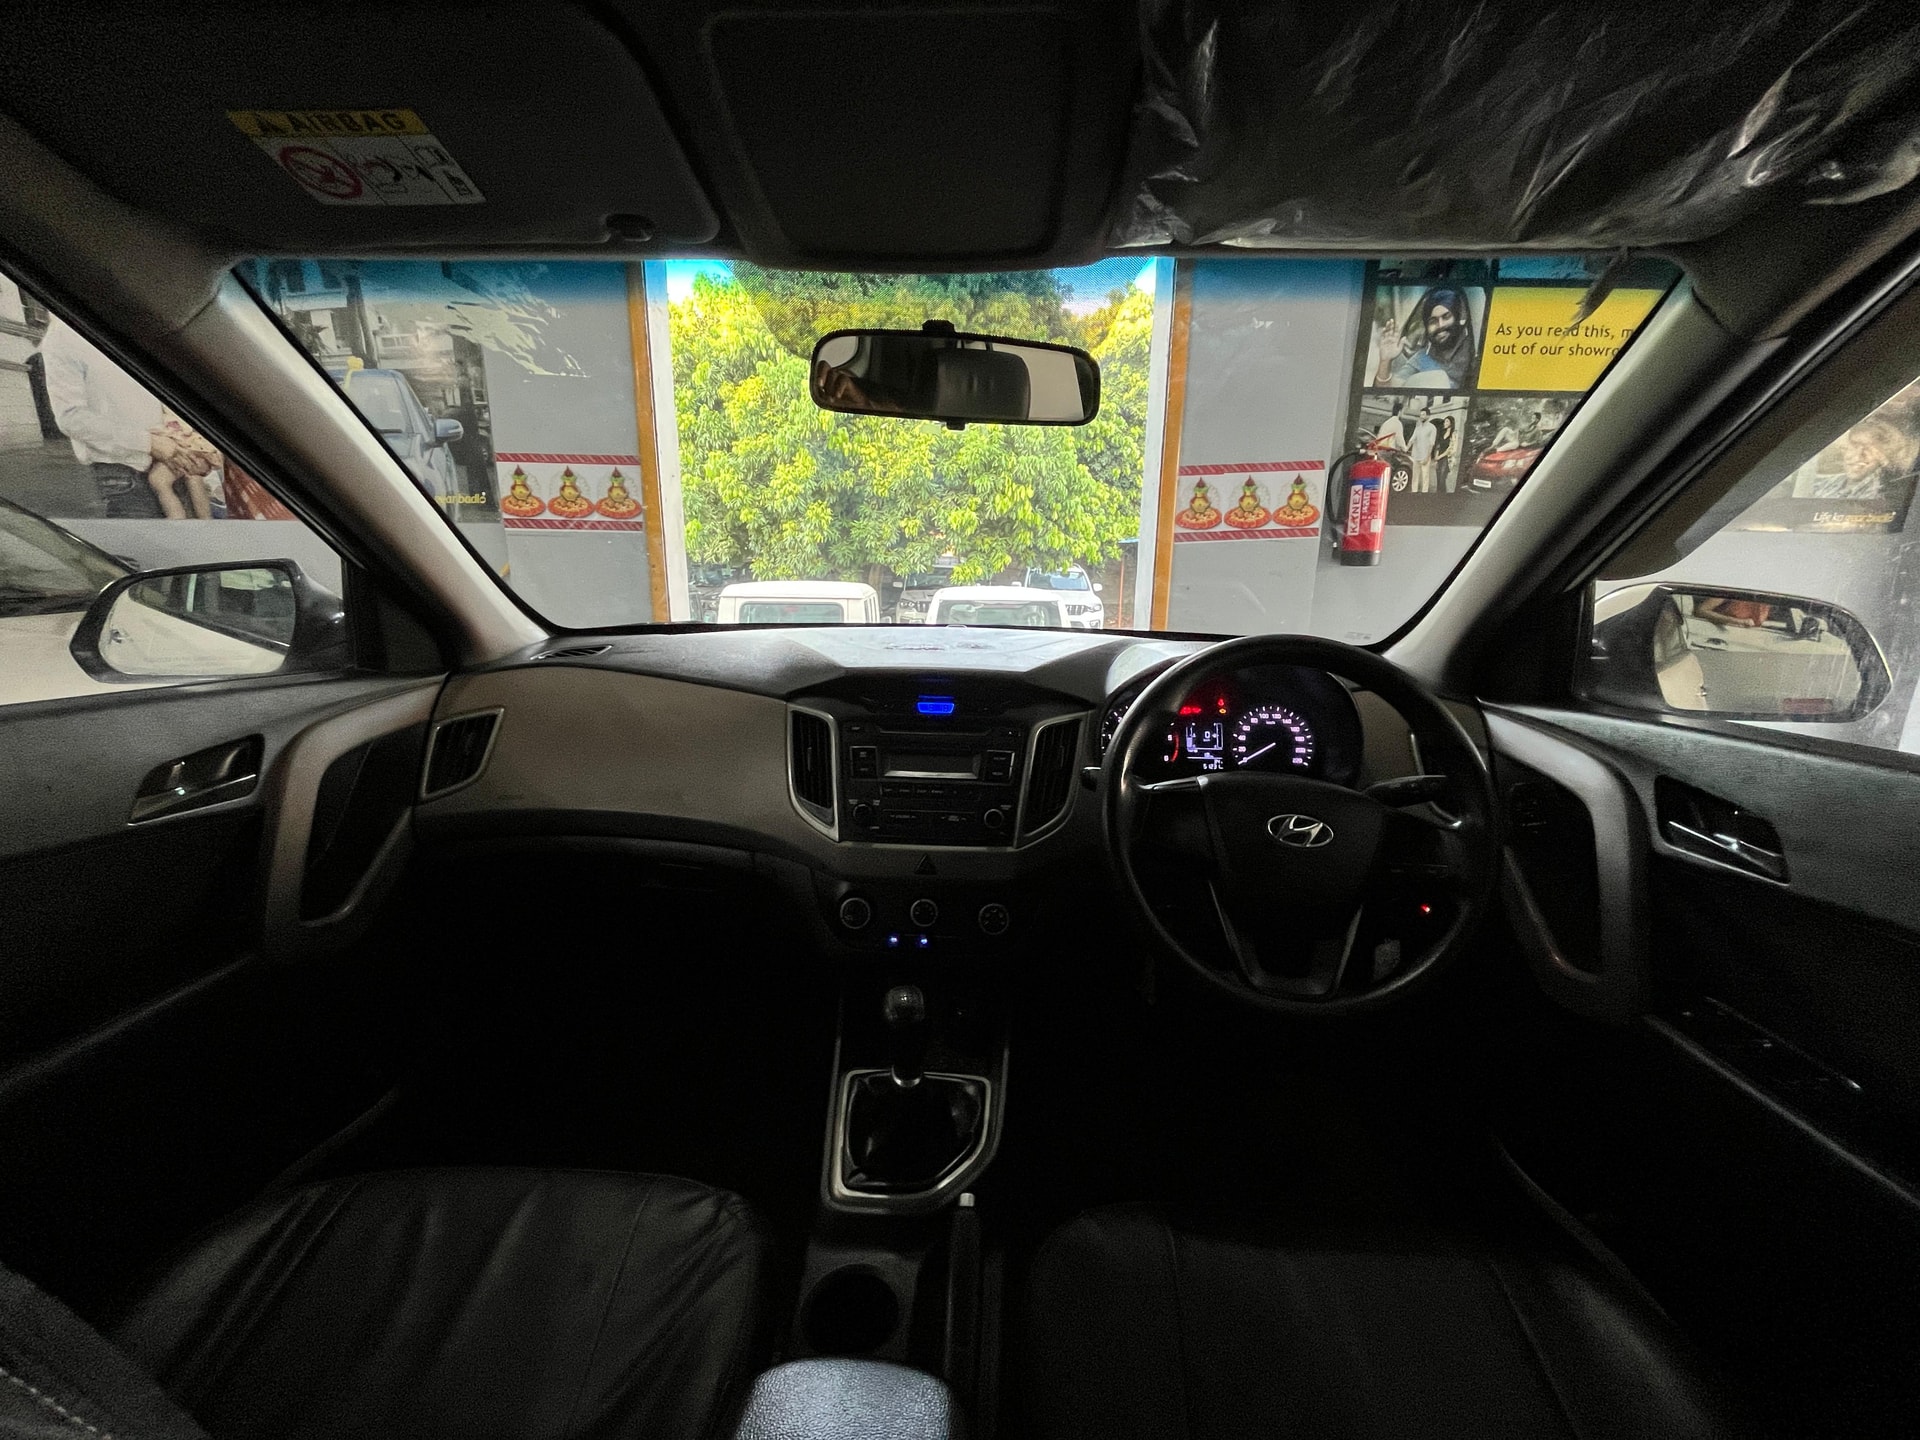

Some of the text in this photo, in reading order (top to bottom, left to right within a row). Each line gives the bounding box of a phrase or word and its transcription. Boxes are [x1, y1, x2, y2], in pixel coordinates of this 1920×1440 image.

[287, 112, 409, 133] AIRBAG
[1495, 323, 1512, 336] As
[1516, 325, 1542, 339] you
[1547, 324, 1580, 337] read
[1584, 324, 1615, 340] this,
[1493, 344, 1516, 355] out
[1521, 342, 1537, 355] of
[1540, 345, 1564, 356] our
[1350, 488, 1361, 534] KANEX
